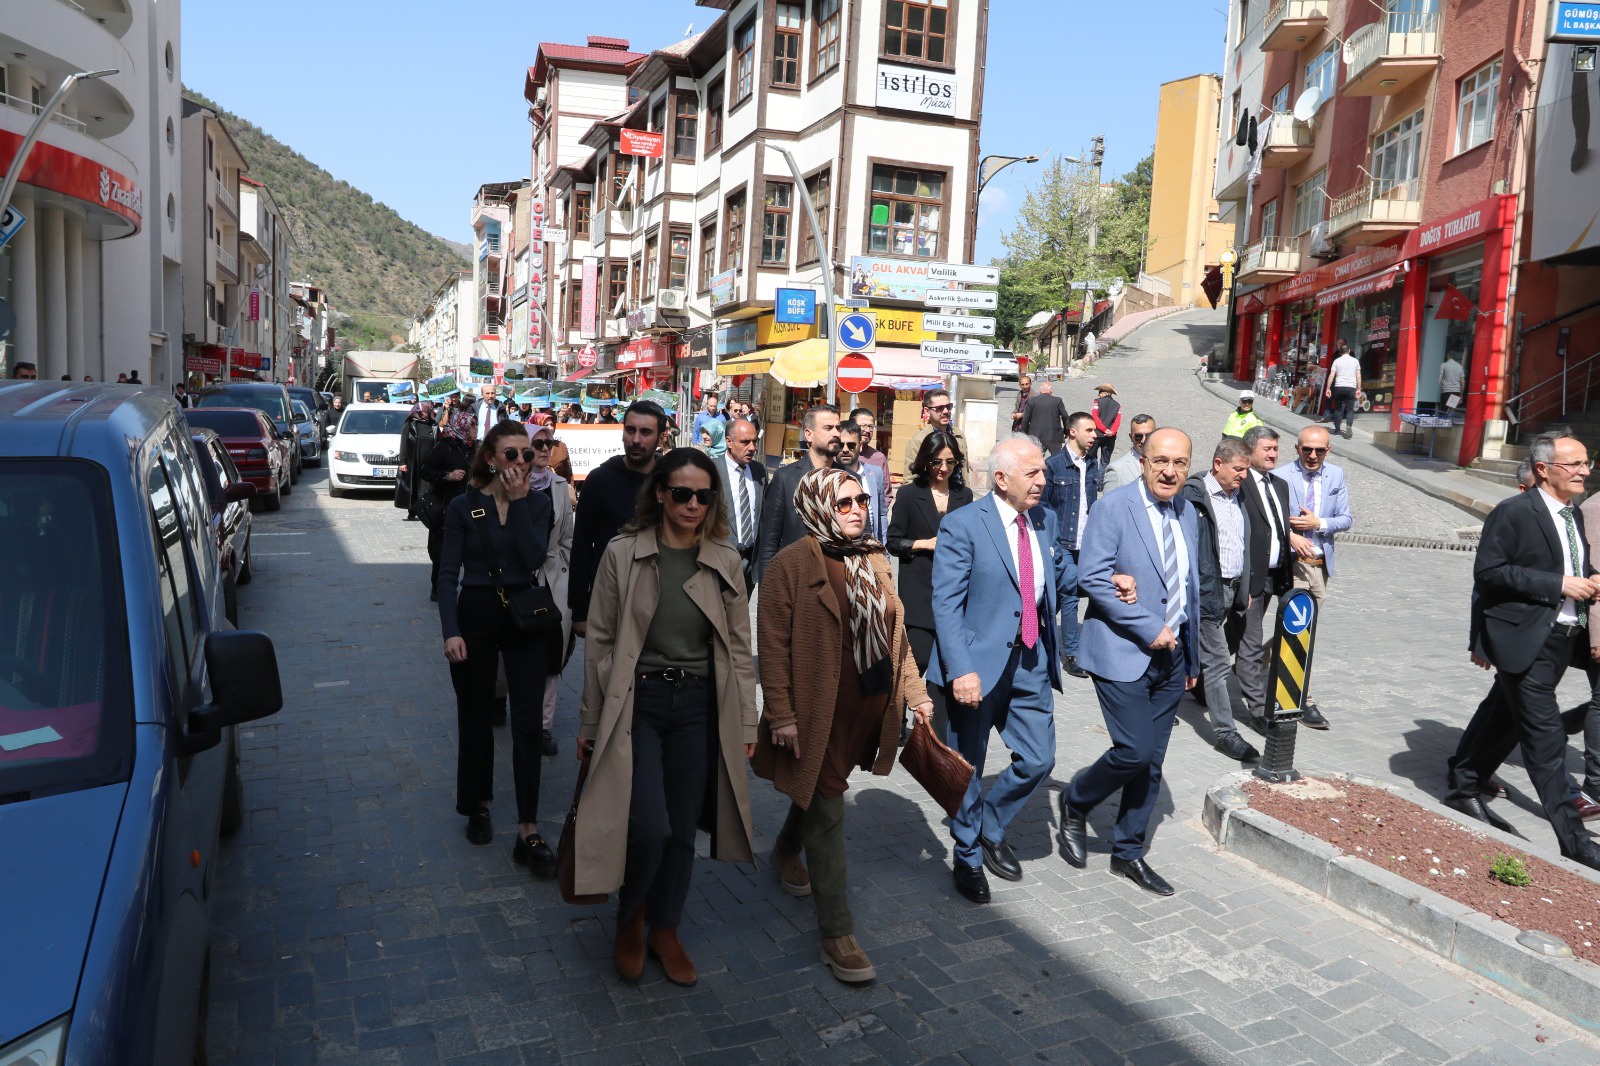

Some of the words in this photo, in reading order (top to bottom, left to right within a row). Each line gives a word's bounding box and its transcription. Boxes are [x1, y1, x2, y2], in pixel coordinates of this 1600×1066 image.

[1564, 8, 1600, 20] GÜMÜŞ
[1563, 20, 1571, 28] İL
[881, 72, 952, 98] istilos
[920, 96, 953, 109] Müzik
[533, 202, 544, 253] OTEL
[1420, 225, 1442, 247] DOĞUŞ
[1444, 209, 1481, 239] TUHAFİYE
[872, 261, 893, 273] GÜL
[931, 268, 957, 277] Valilik
[1341, 282, 1374, 298] LOKMAN
[787, 298, 806, 308] KÖŞK
[928, 294, 955, 302] Askerlik
[956, 295, 979, 303] Şubesi
[529, 272, 543, 349] ATALAY
[787, 306, 806, 315] BÜFE
[888, 317, 914, 331] BÜFE
[942, 320, 957, 328] Eğt.
[924, 345, 969, 355] Kütüphane
